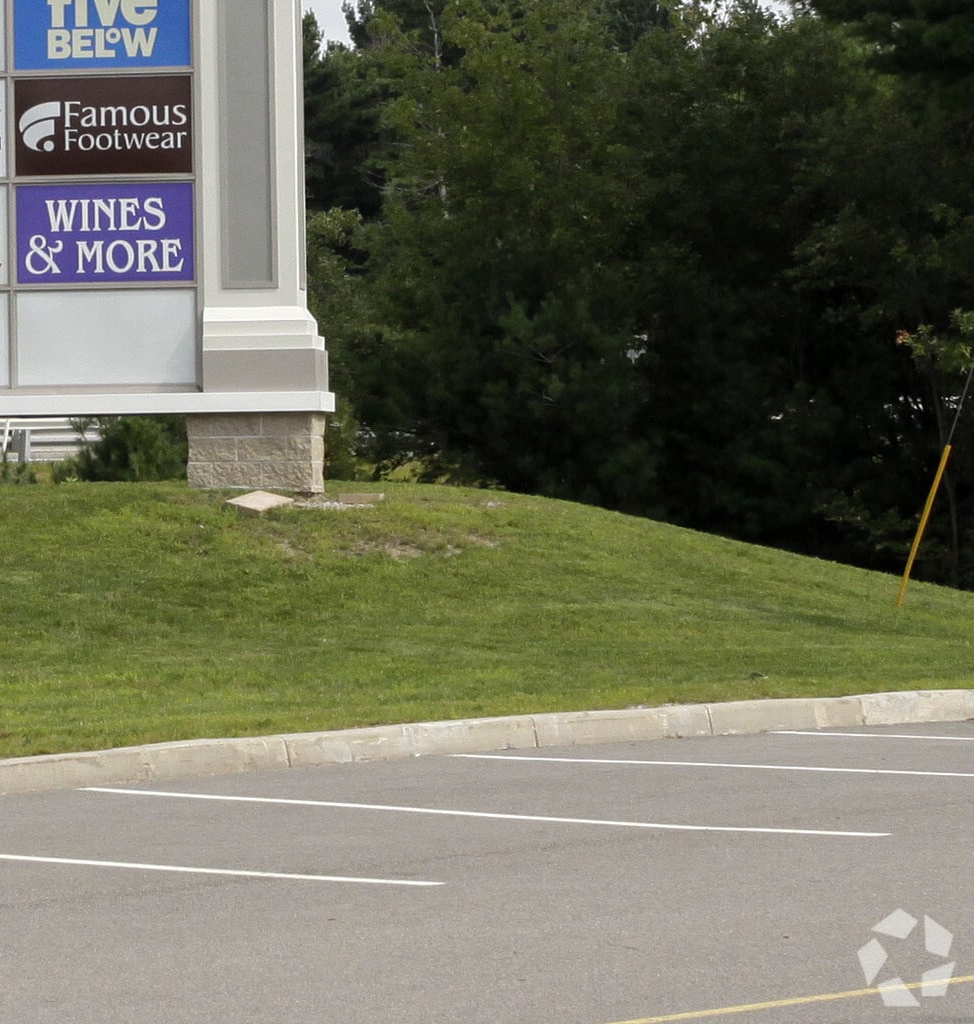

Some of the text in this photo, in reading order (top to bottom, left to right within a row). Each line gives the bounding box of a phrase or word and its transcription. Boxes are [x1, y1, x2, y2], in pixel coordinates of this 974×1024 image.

[63, 101, 188, 128] Famous
[63, 129, 188, 152] Footwear
[44, 196, 167, 232] WINES
[25, 234, 185, 275] & MORE
